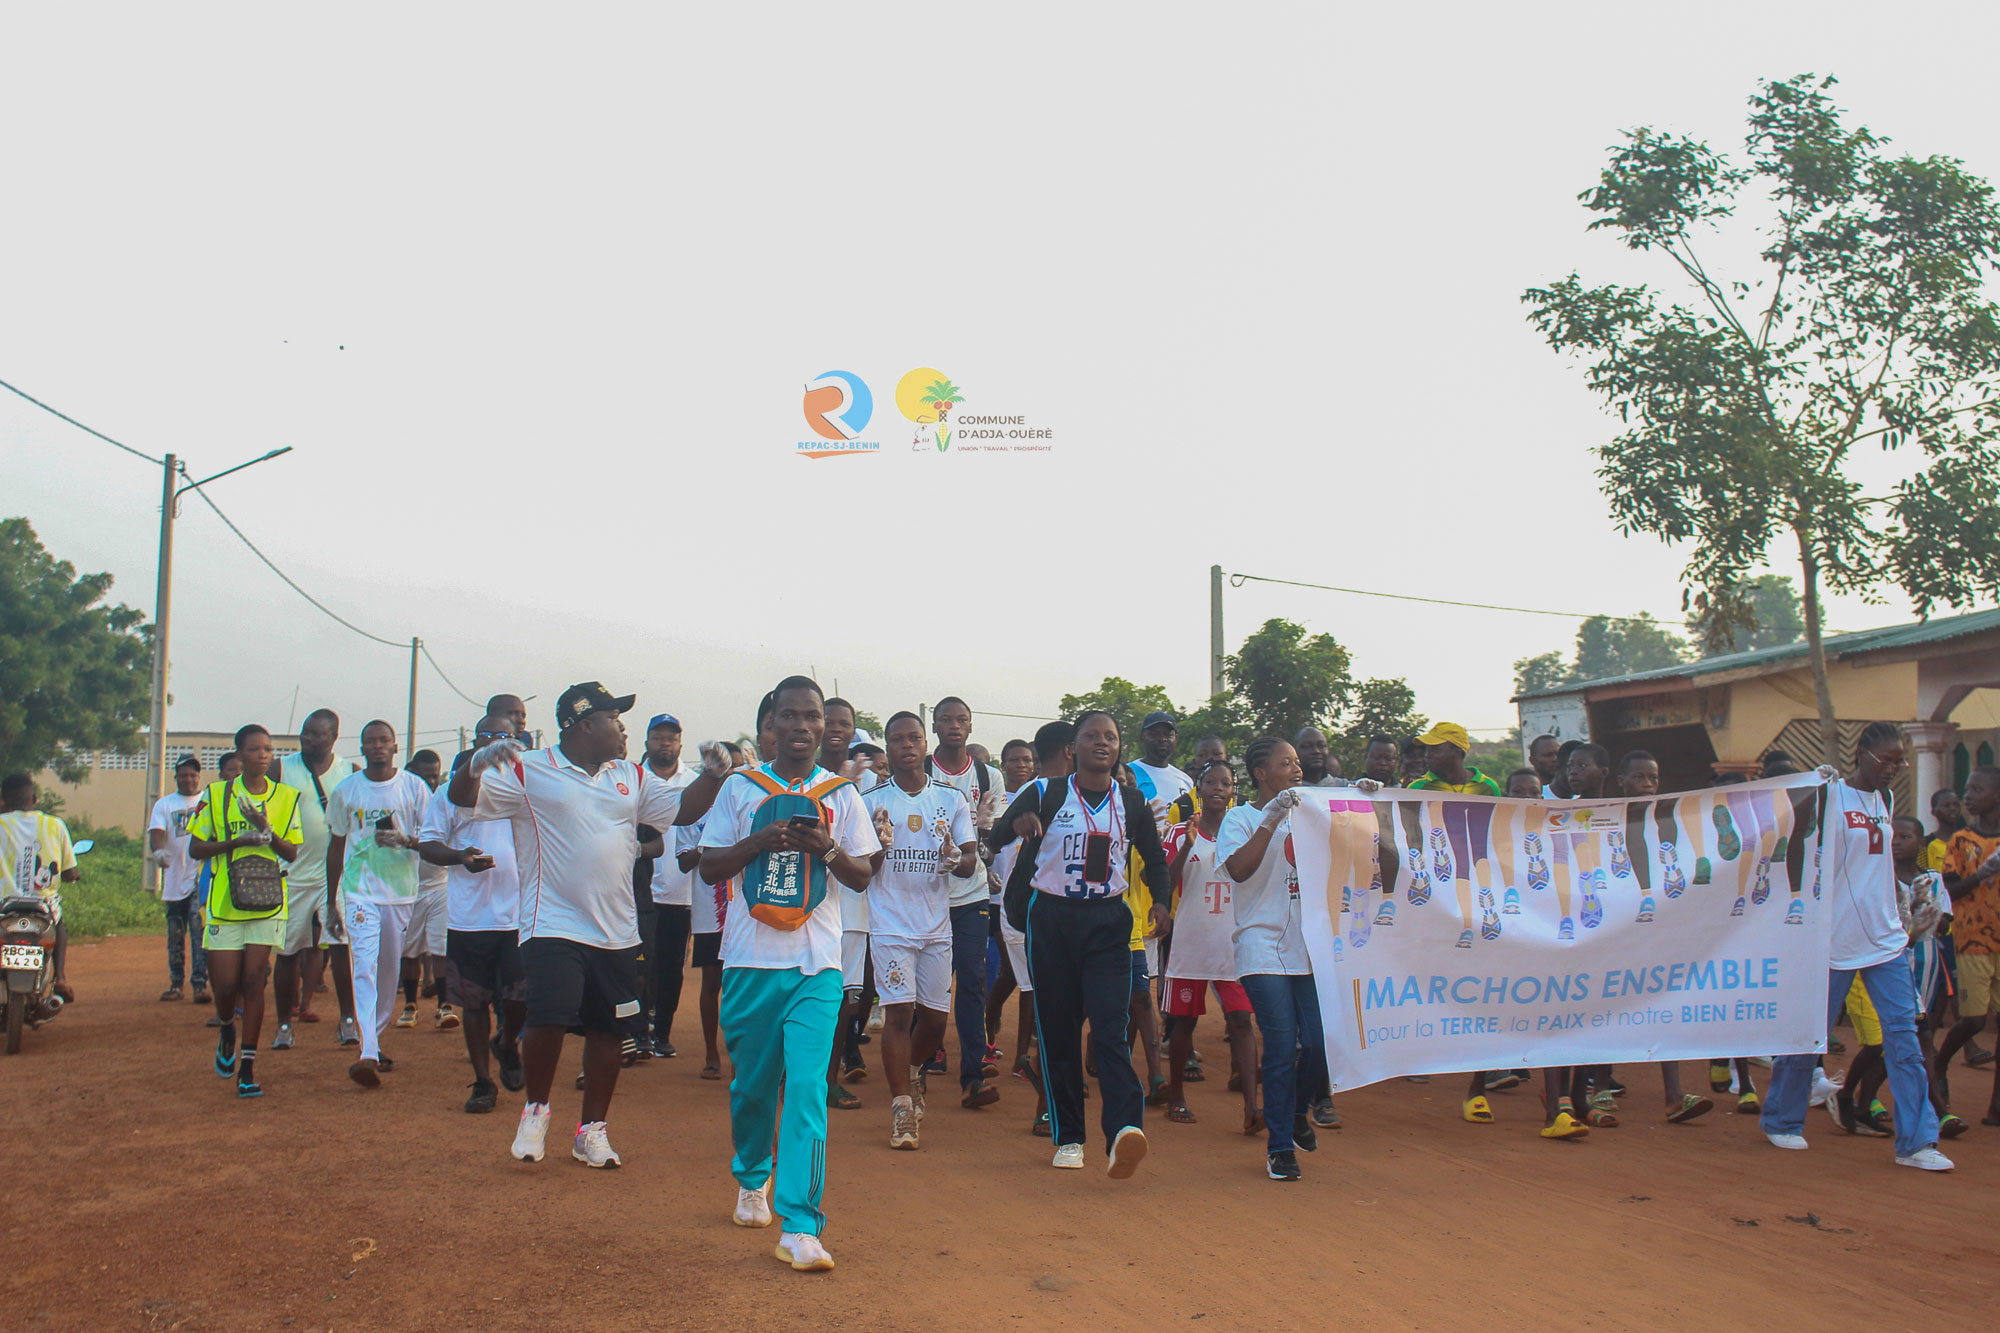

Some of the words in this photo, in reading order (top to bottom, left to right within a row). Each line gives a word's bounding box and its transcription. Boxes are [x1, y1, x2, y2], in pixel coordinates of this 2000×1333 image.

[885, 846, 939, 861] Emirate
[892, 861, 907, 873] FLY
[908, 861, 936, 874] BETTER
[1365, 972, 1591, 1010] MARCHONS
[1601, 957, 1779, 998] ENSEMBLE
[1367, 1023, 1410, 1048] pour
[1415, 1019, 1433, 1038] la
[1440, 1016, 1503, 1036] TERRE,
[1510, 1015, 1530, 1032] la
[1536, 1012, 1586, 1031] PAIX
[1591, 1009, 1612, 1028] et
[1618, 1006, 1673, 1026] notre
[1681, 1004, 1727, 1023] BIEN
[1734, 999, 1778, 1021] ÊTRE
